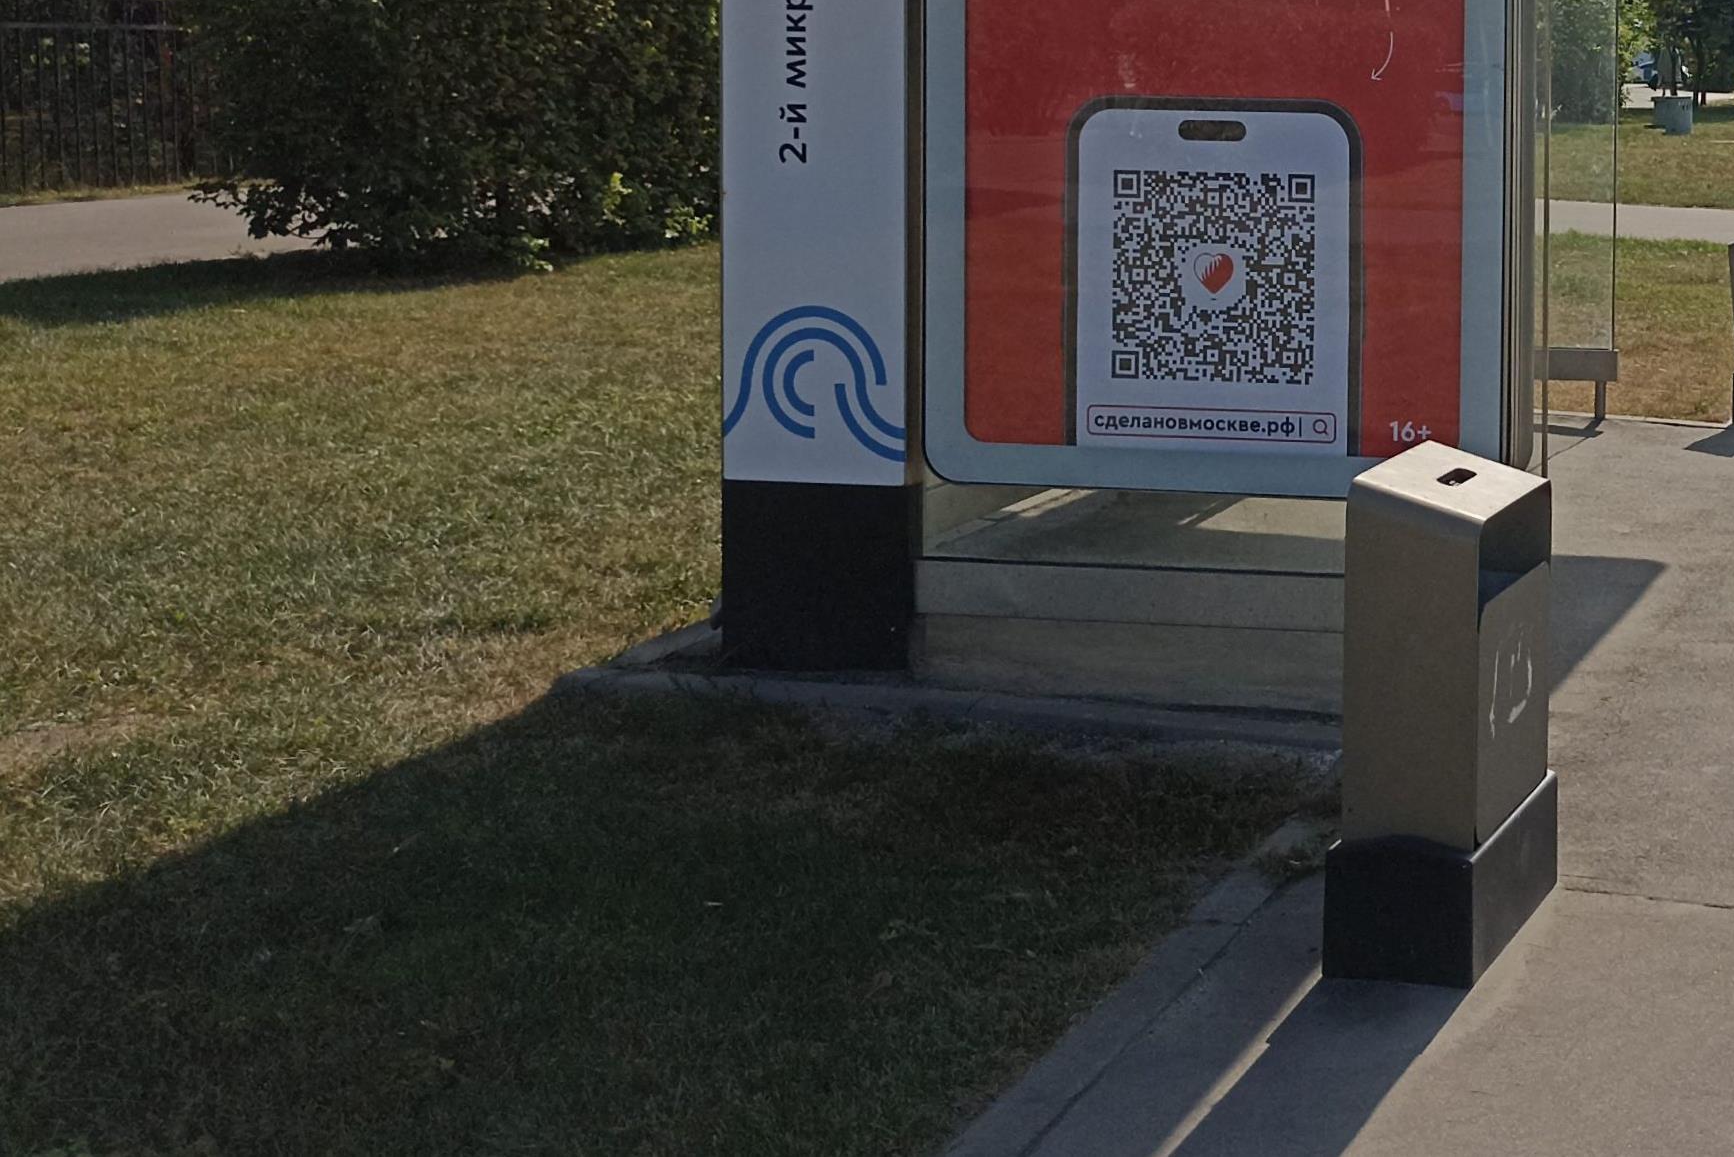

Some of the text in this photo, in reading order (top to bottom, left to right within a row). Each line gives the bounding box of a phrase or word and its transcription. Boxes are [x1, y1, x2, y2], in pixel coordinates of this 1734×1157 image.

[778, 103, 808, 165] 2-й
[1094, 411, 1295, 436] сделановмоскве.рф
[1389, 419, 1432, 444] 16+
